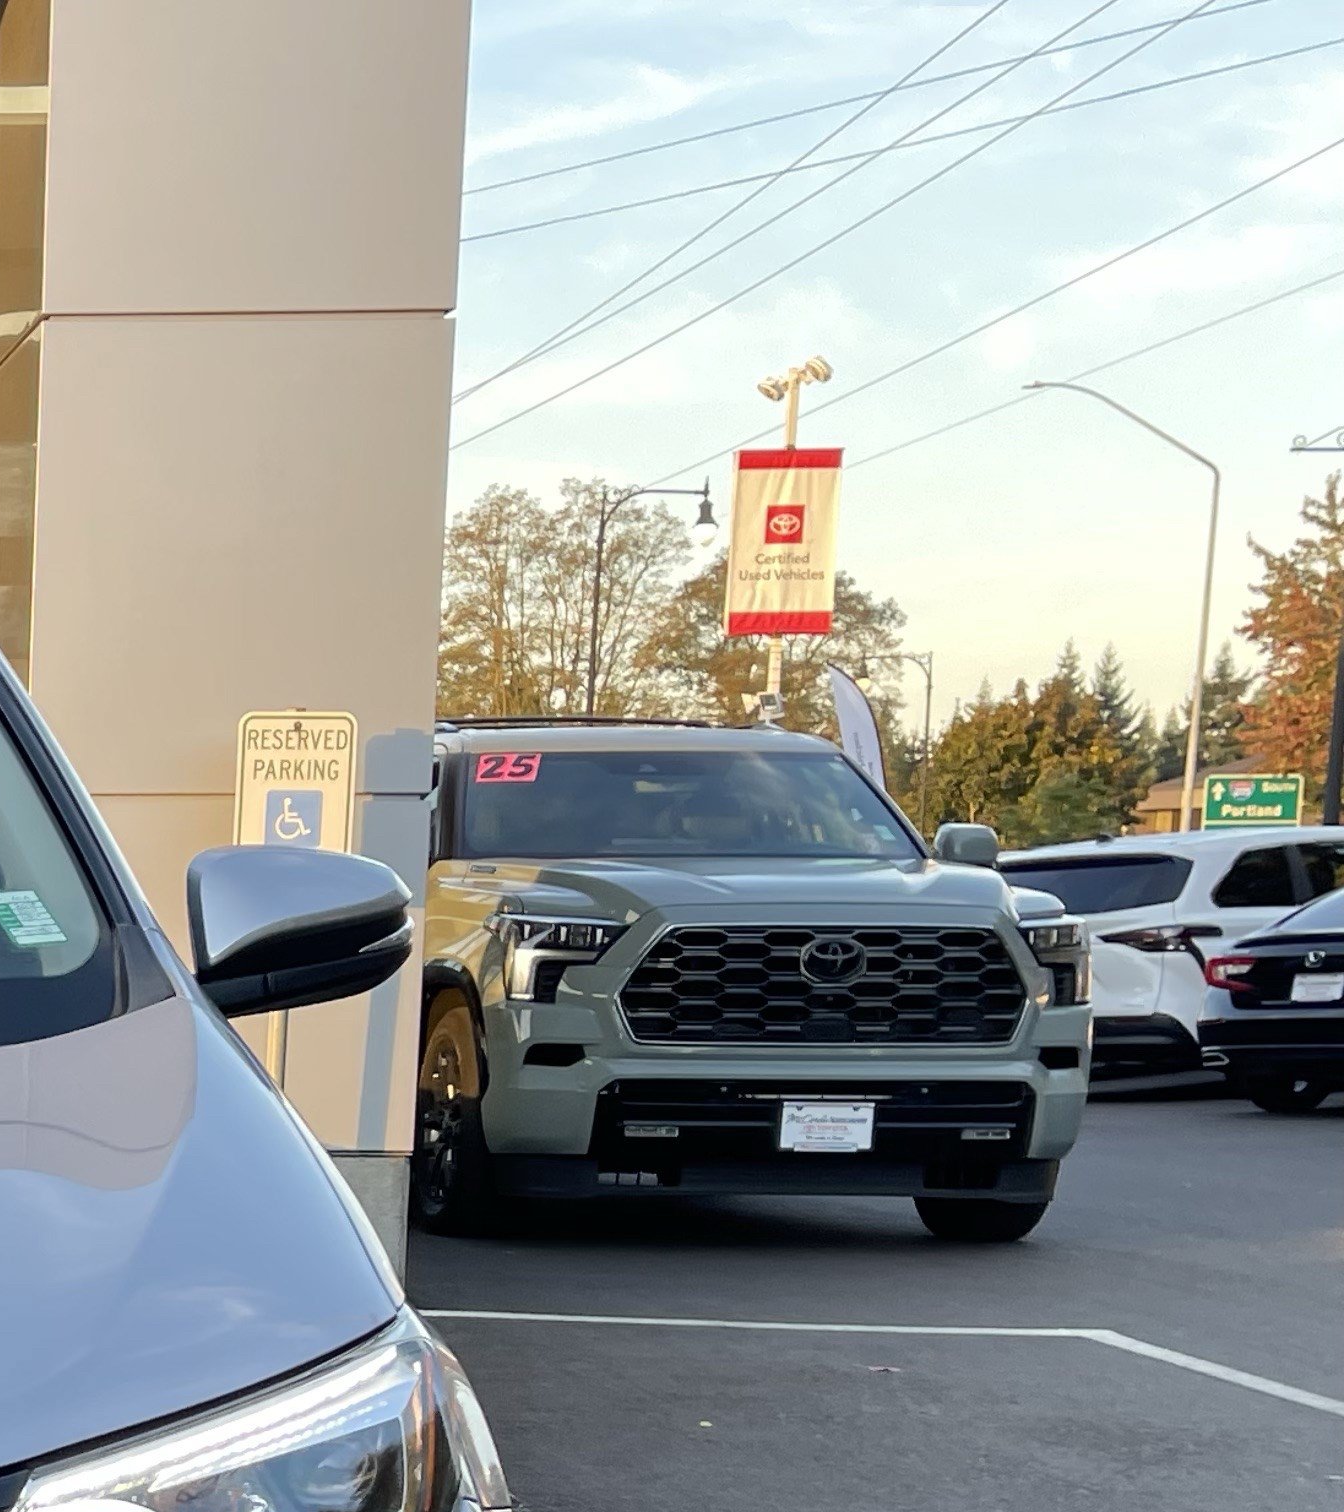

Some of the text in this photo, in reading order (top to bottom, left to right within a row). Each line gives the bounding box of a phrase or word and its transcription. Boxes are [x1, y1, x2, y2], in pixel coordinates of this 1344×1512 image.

[754, 552, 811, 565] Certified
[739, 568, 825, 582] Used Vehicles
[247, 728, 349, 751] RESERVED
[252, 759, 340, 781] PARKING
[479, 754, 537, 779] 25
[1220, 803, 1283, 817] Portland
